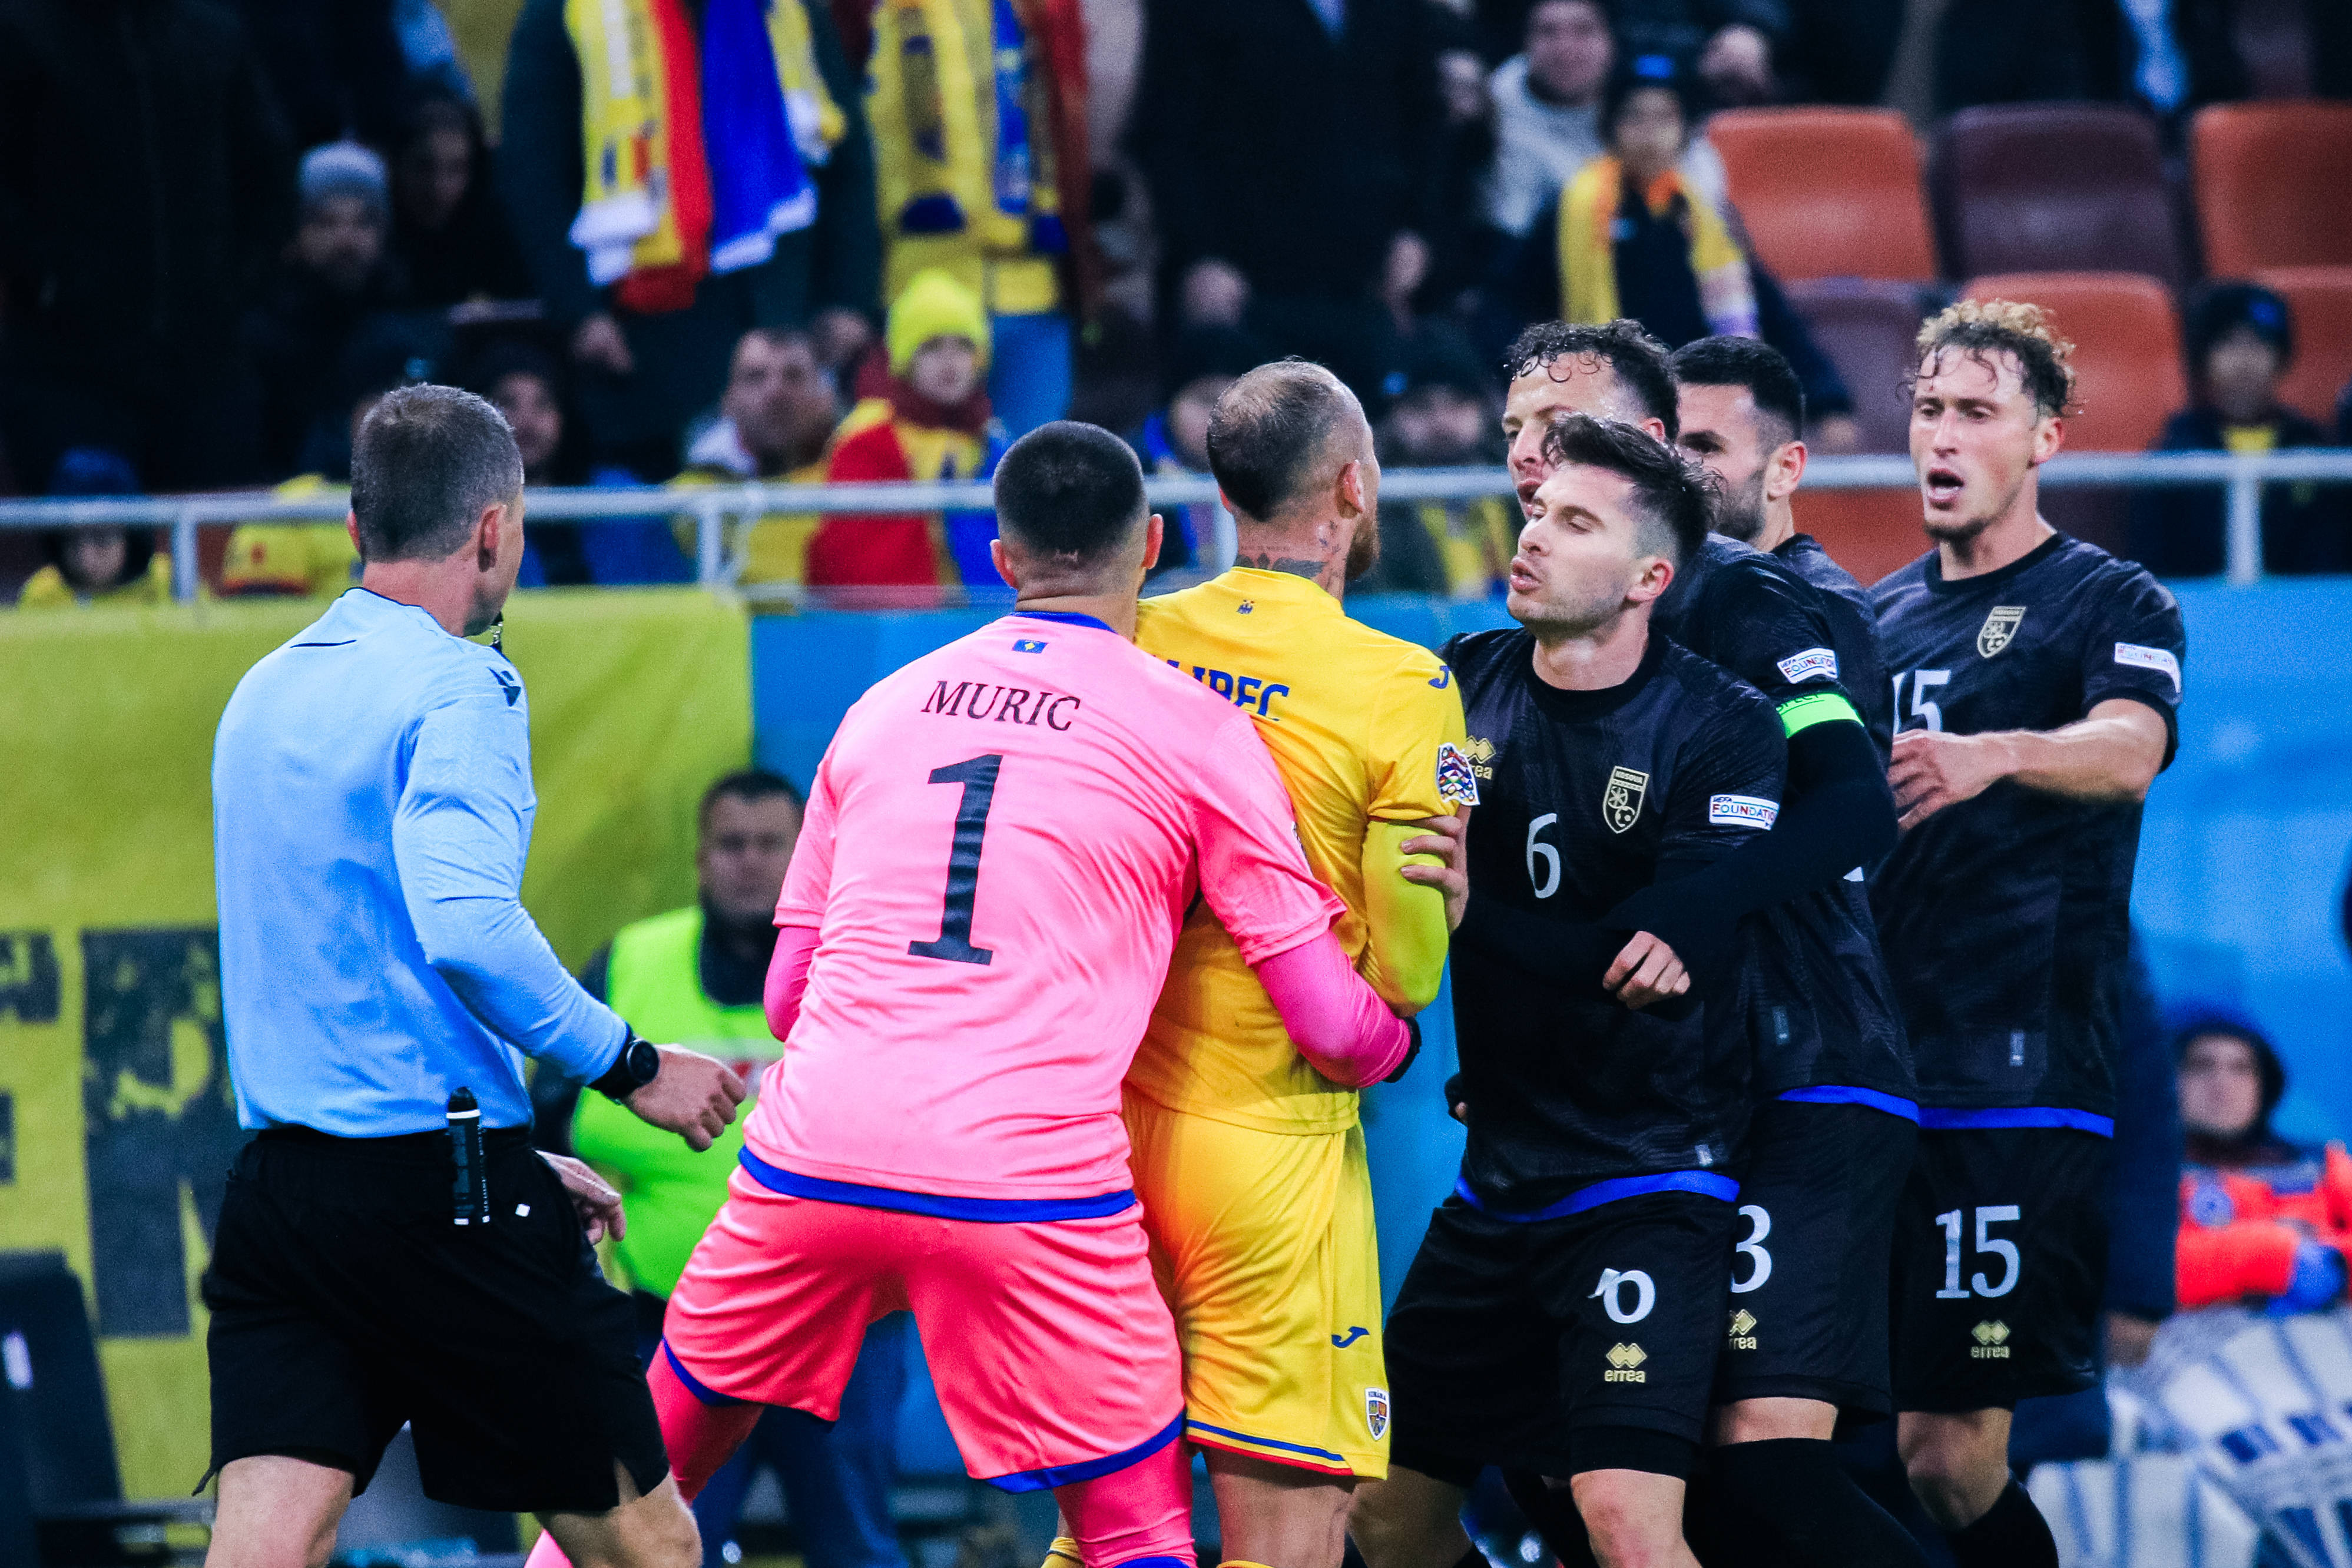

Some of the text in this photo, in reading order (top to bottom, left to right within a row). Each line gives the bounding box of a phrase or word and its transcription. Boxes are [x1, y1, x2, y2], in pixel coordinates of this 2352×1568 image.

[921, 679, 1082, 731] MURIC
[907, 753, 1004, 966] 1
[1526, 813, 1561, 899] 6
[1934, 1204, 2021, 1298] 15
